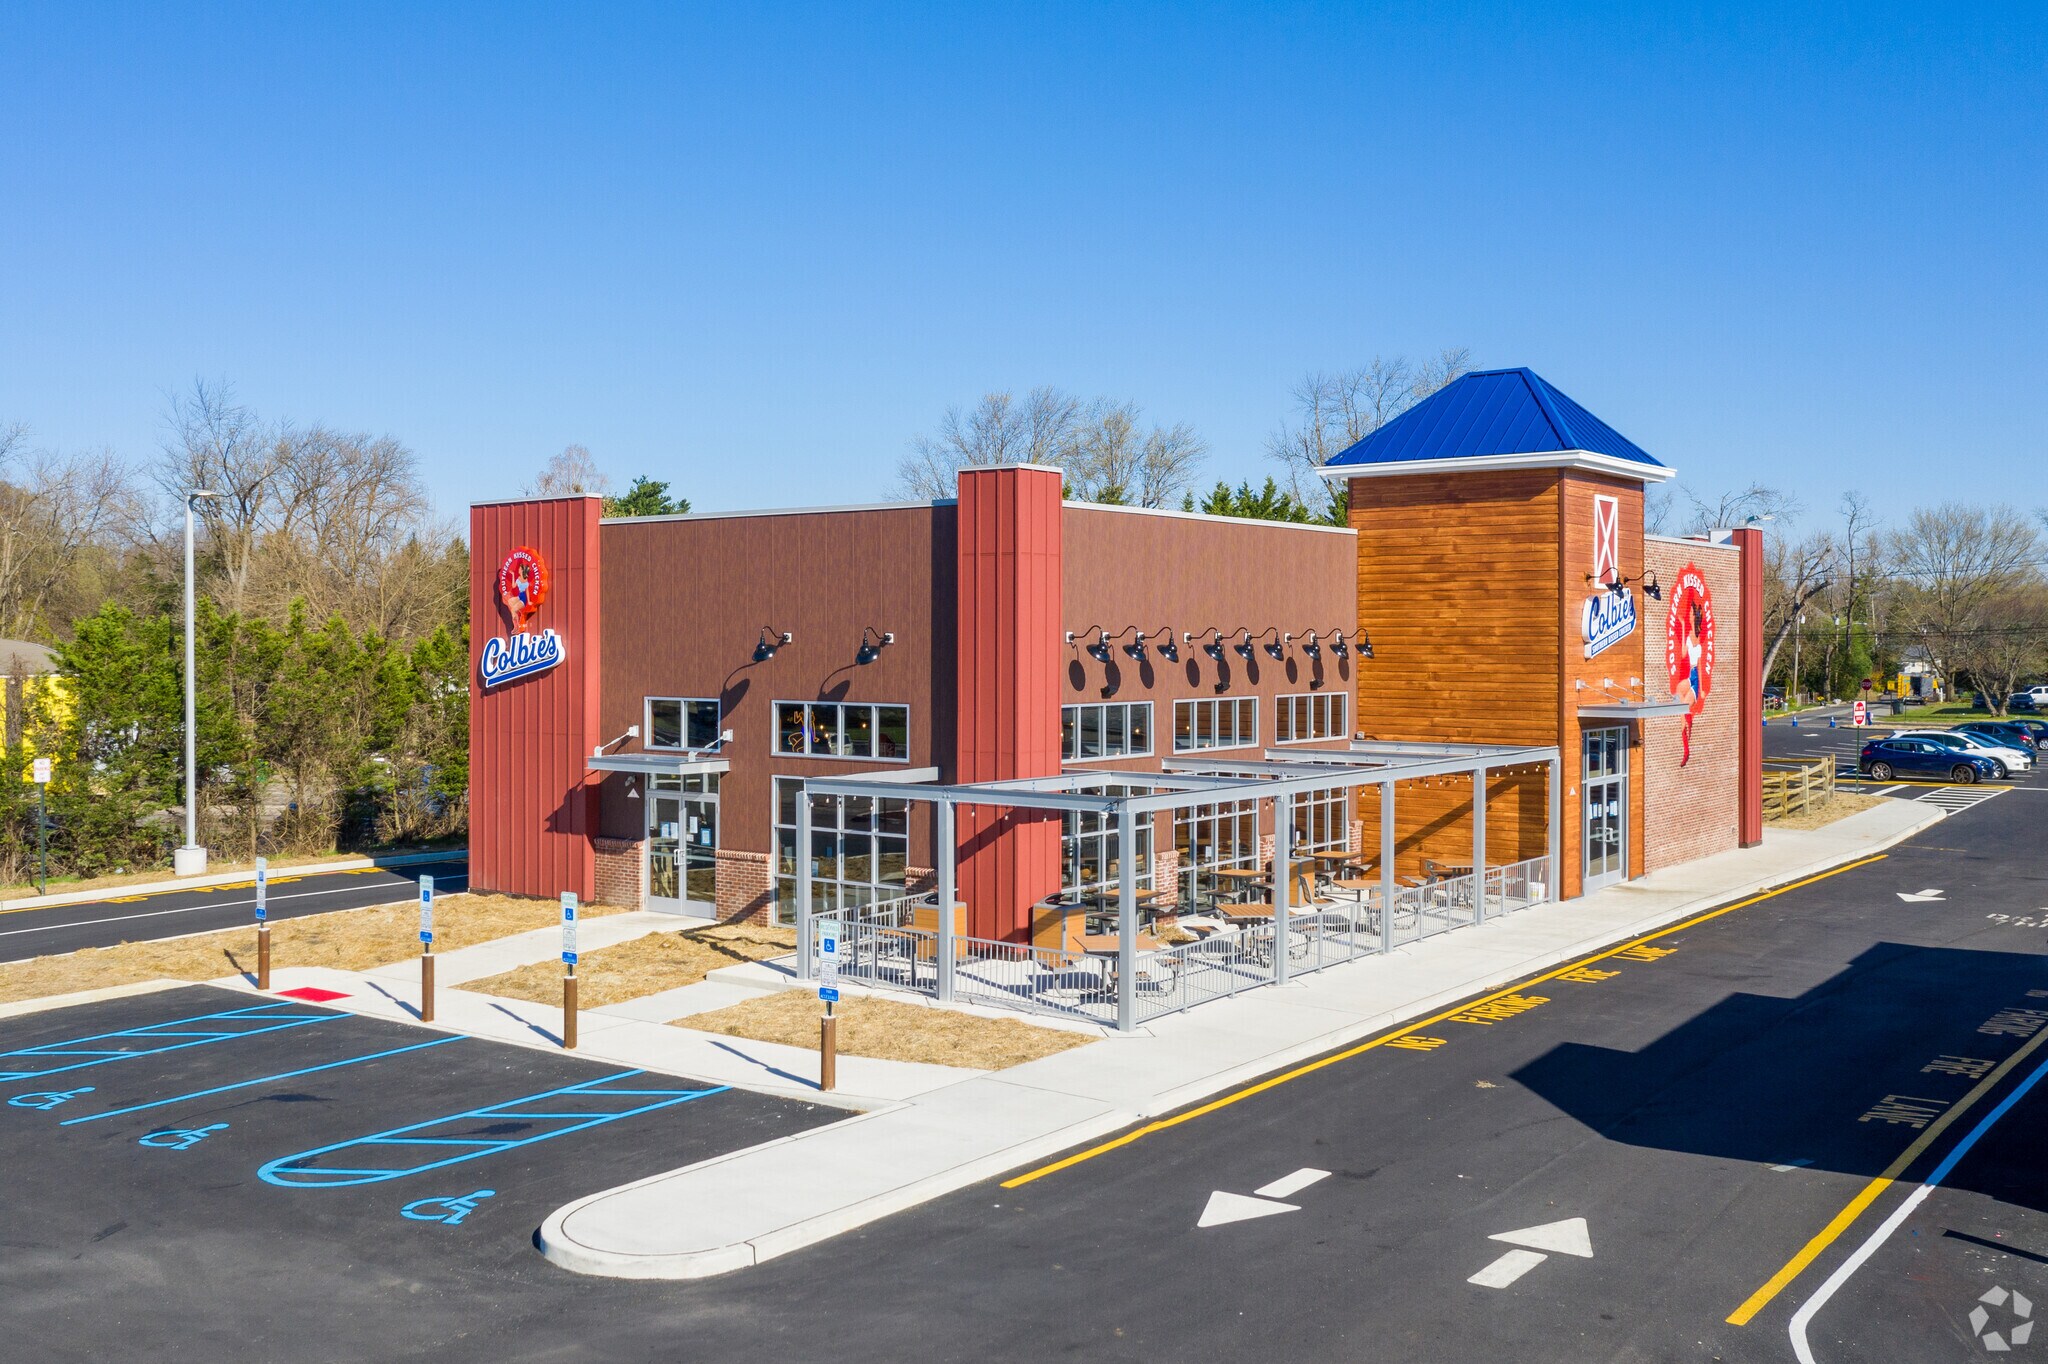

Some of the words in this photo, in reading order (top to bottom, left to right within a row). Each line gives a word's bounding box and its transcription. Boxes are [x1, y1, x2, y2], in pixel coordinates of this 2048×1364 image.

[501, 557, 513, 596] SOUTHERN
[513, 551, 532, 562] KISSED
[531, 562, 542, 596] CHICKEN
[1588, 589, 1636, 641] Colbie's
[1668, 583, 1683, 676] SOUTHERN
[1683, 573, 1704, 598] KISSED
[1704, 600, 1713, 675] CHICKEN
[483, 630, 559, 679] Colbie's
[1448, 994, 1551, 1025] PARKING
[1555, 967, 1622, 984] FIRE
[1611, 945, 1678, 963] LANE
[1919, 1054, 1997, 1079] FIRE
[1857, 1094, 1950, 1129] LANE
